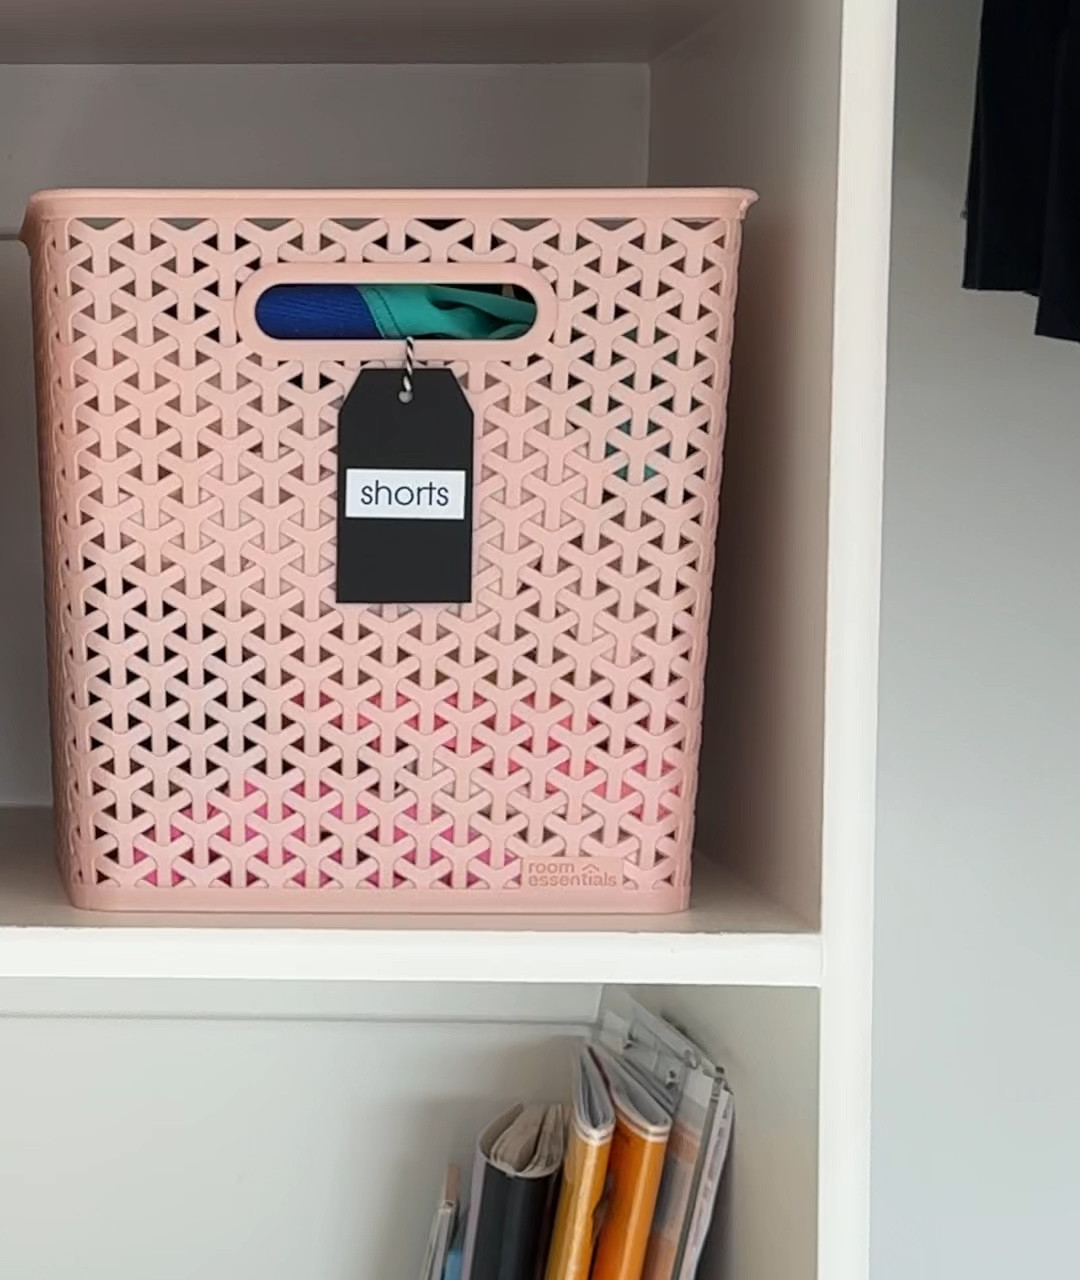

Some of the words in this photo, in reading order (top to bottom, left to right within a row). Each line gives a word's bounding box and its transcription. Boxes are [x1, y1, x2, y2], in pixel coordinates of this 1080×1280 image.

[360, 479, 449, 507] shorts
[528, 862, 575, 874] room
[528, 872, 617, 887] essentials
